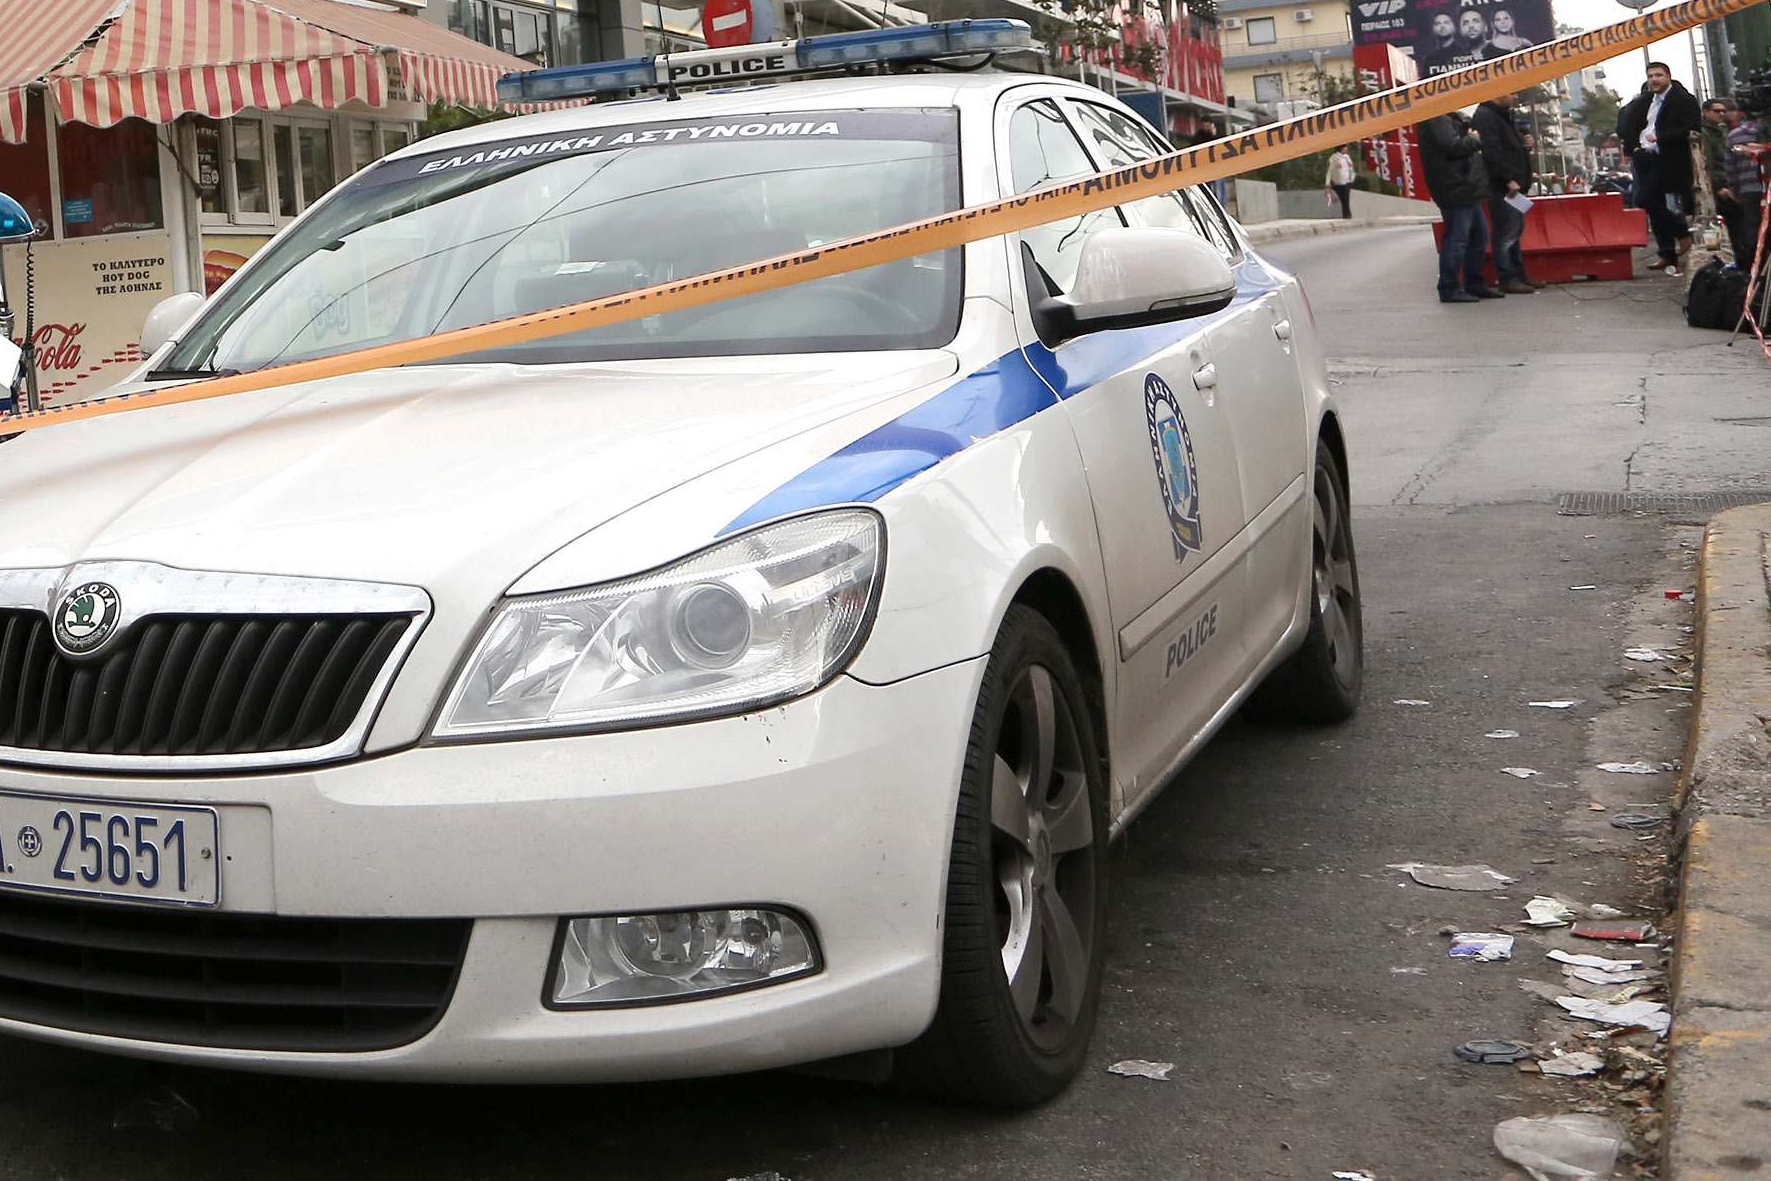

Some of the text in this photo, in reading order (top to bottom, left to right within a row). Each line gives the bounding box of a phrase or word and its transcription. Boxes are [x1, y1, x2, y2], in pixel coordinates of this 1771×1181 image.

[668, 55, 785, 80] POLICE
[419, 120, 841, 174] ΕΛΛΗΝΙΚΗ ΑΣΤΥΝΟΜΙΑ
[92, 257, 165, 272] ΤΟ ΚΑΛΥΤΕΡΟ
[102, 271, 150, 283] HOT DOG
[95, 282, 162, 295] ΤΗΣ ΑΘΗΝΑΣ
[1165, 604, 1218, 679] POLICE
[53, 809, 188, 892] 25651
